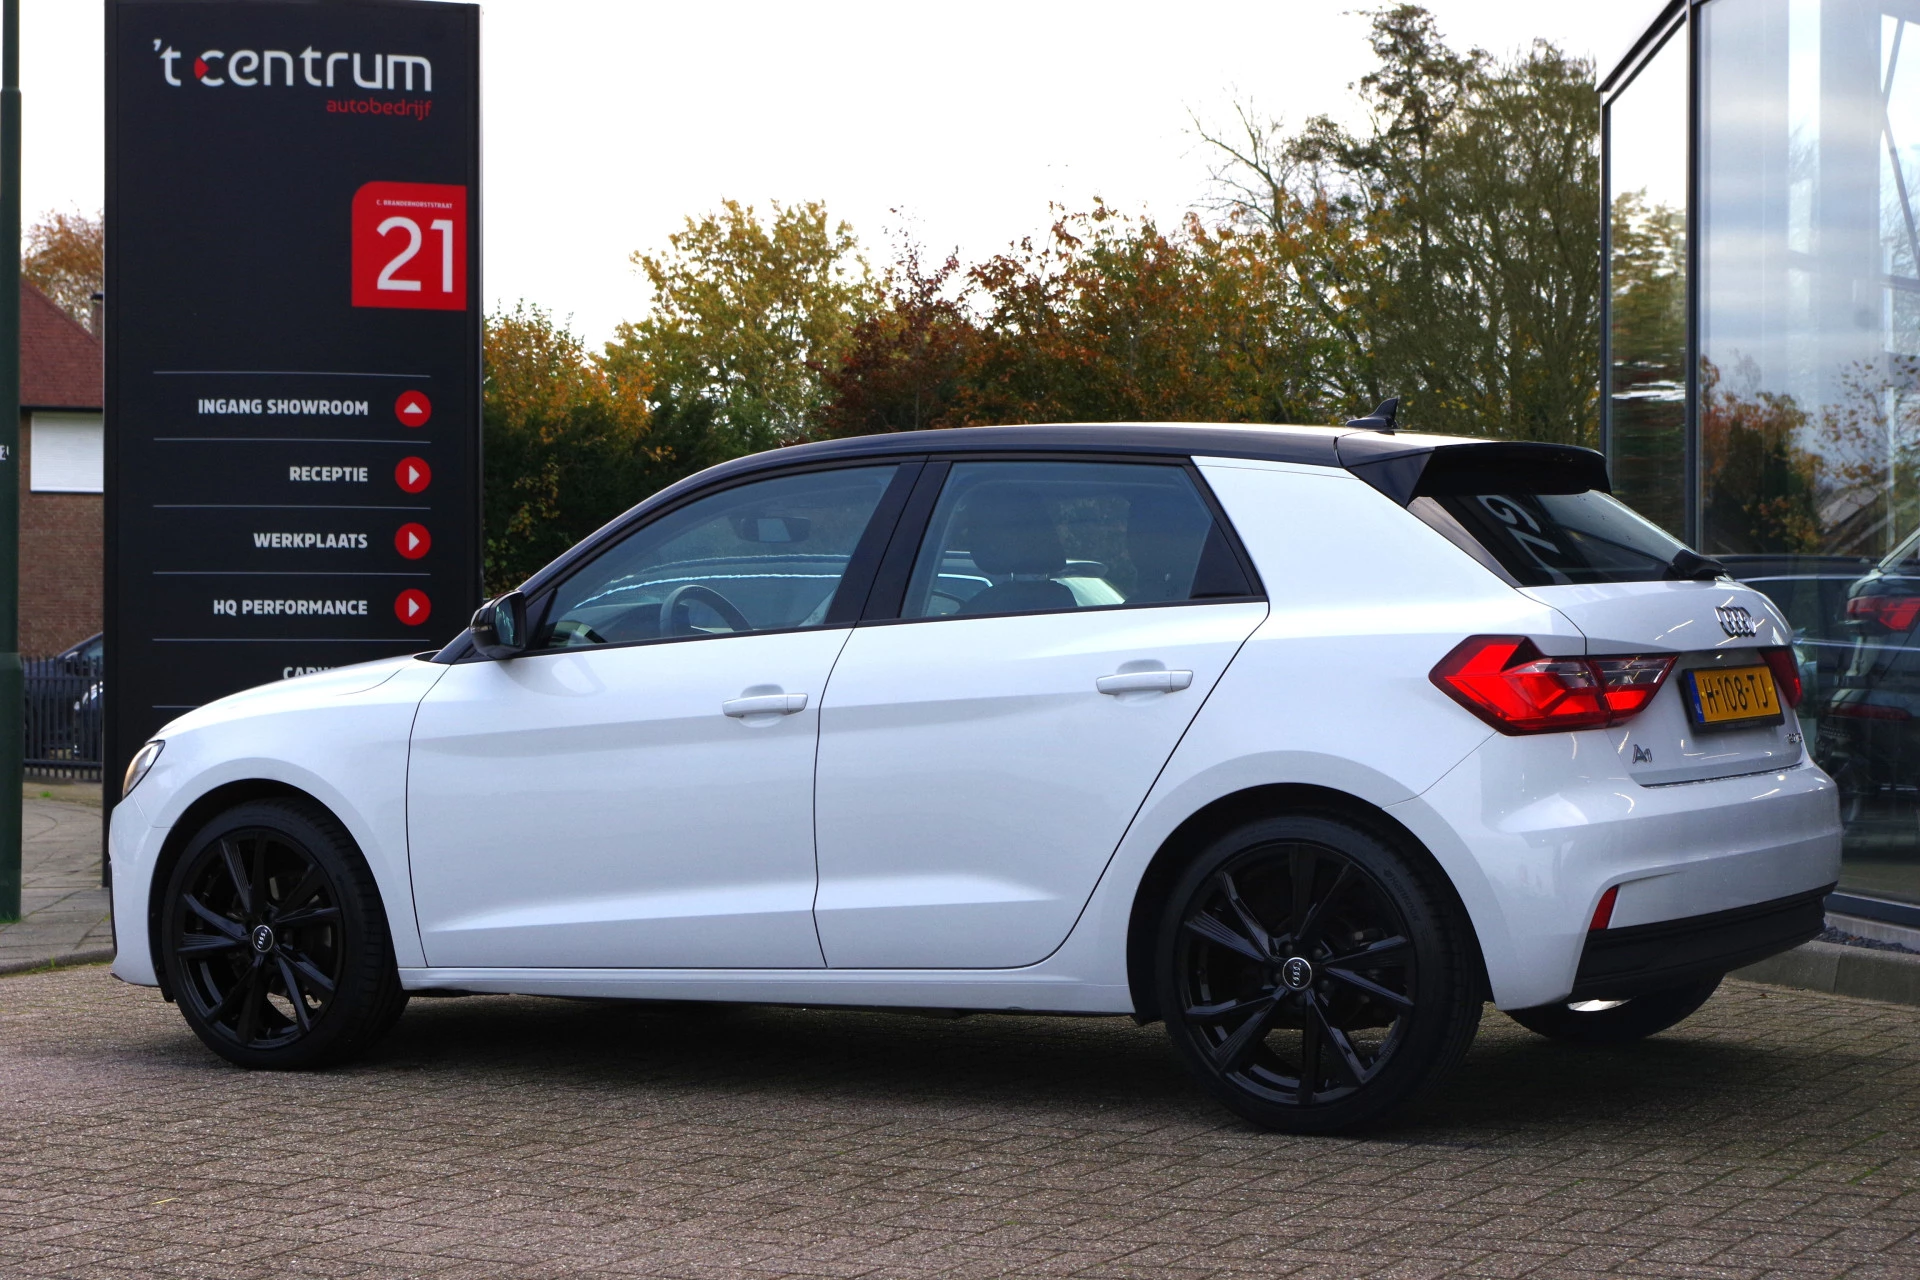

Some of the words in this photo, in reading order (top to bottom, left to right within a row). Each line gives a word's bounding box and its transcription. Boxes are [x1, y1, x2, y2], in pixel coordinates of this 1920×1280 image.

[197, 45, 432, 92] centrum
[326, 97, 432, 121] autobedrijf
[376, 216, 453, 293] 21
[198, 399, 262, 414] INGANG
[266, 399, 368, 415] SHOWROOM
[289, 466, 368, 482] RECEPTIE
[253, 532, 368, 549] WERKPLAATS
[213, 600, 237, 616] HQ
[242, 600, 368, 615] PERFORMANCE
[1702, 673, 1769, 714] H-108-TJ
